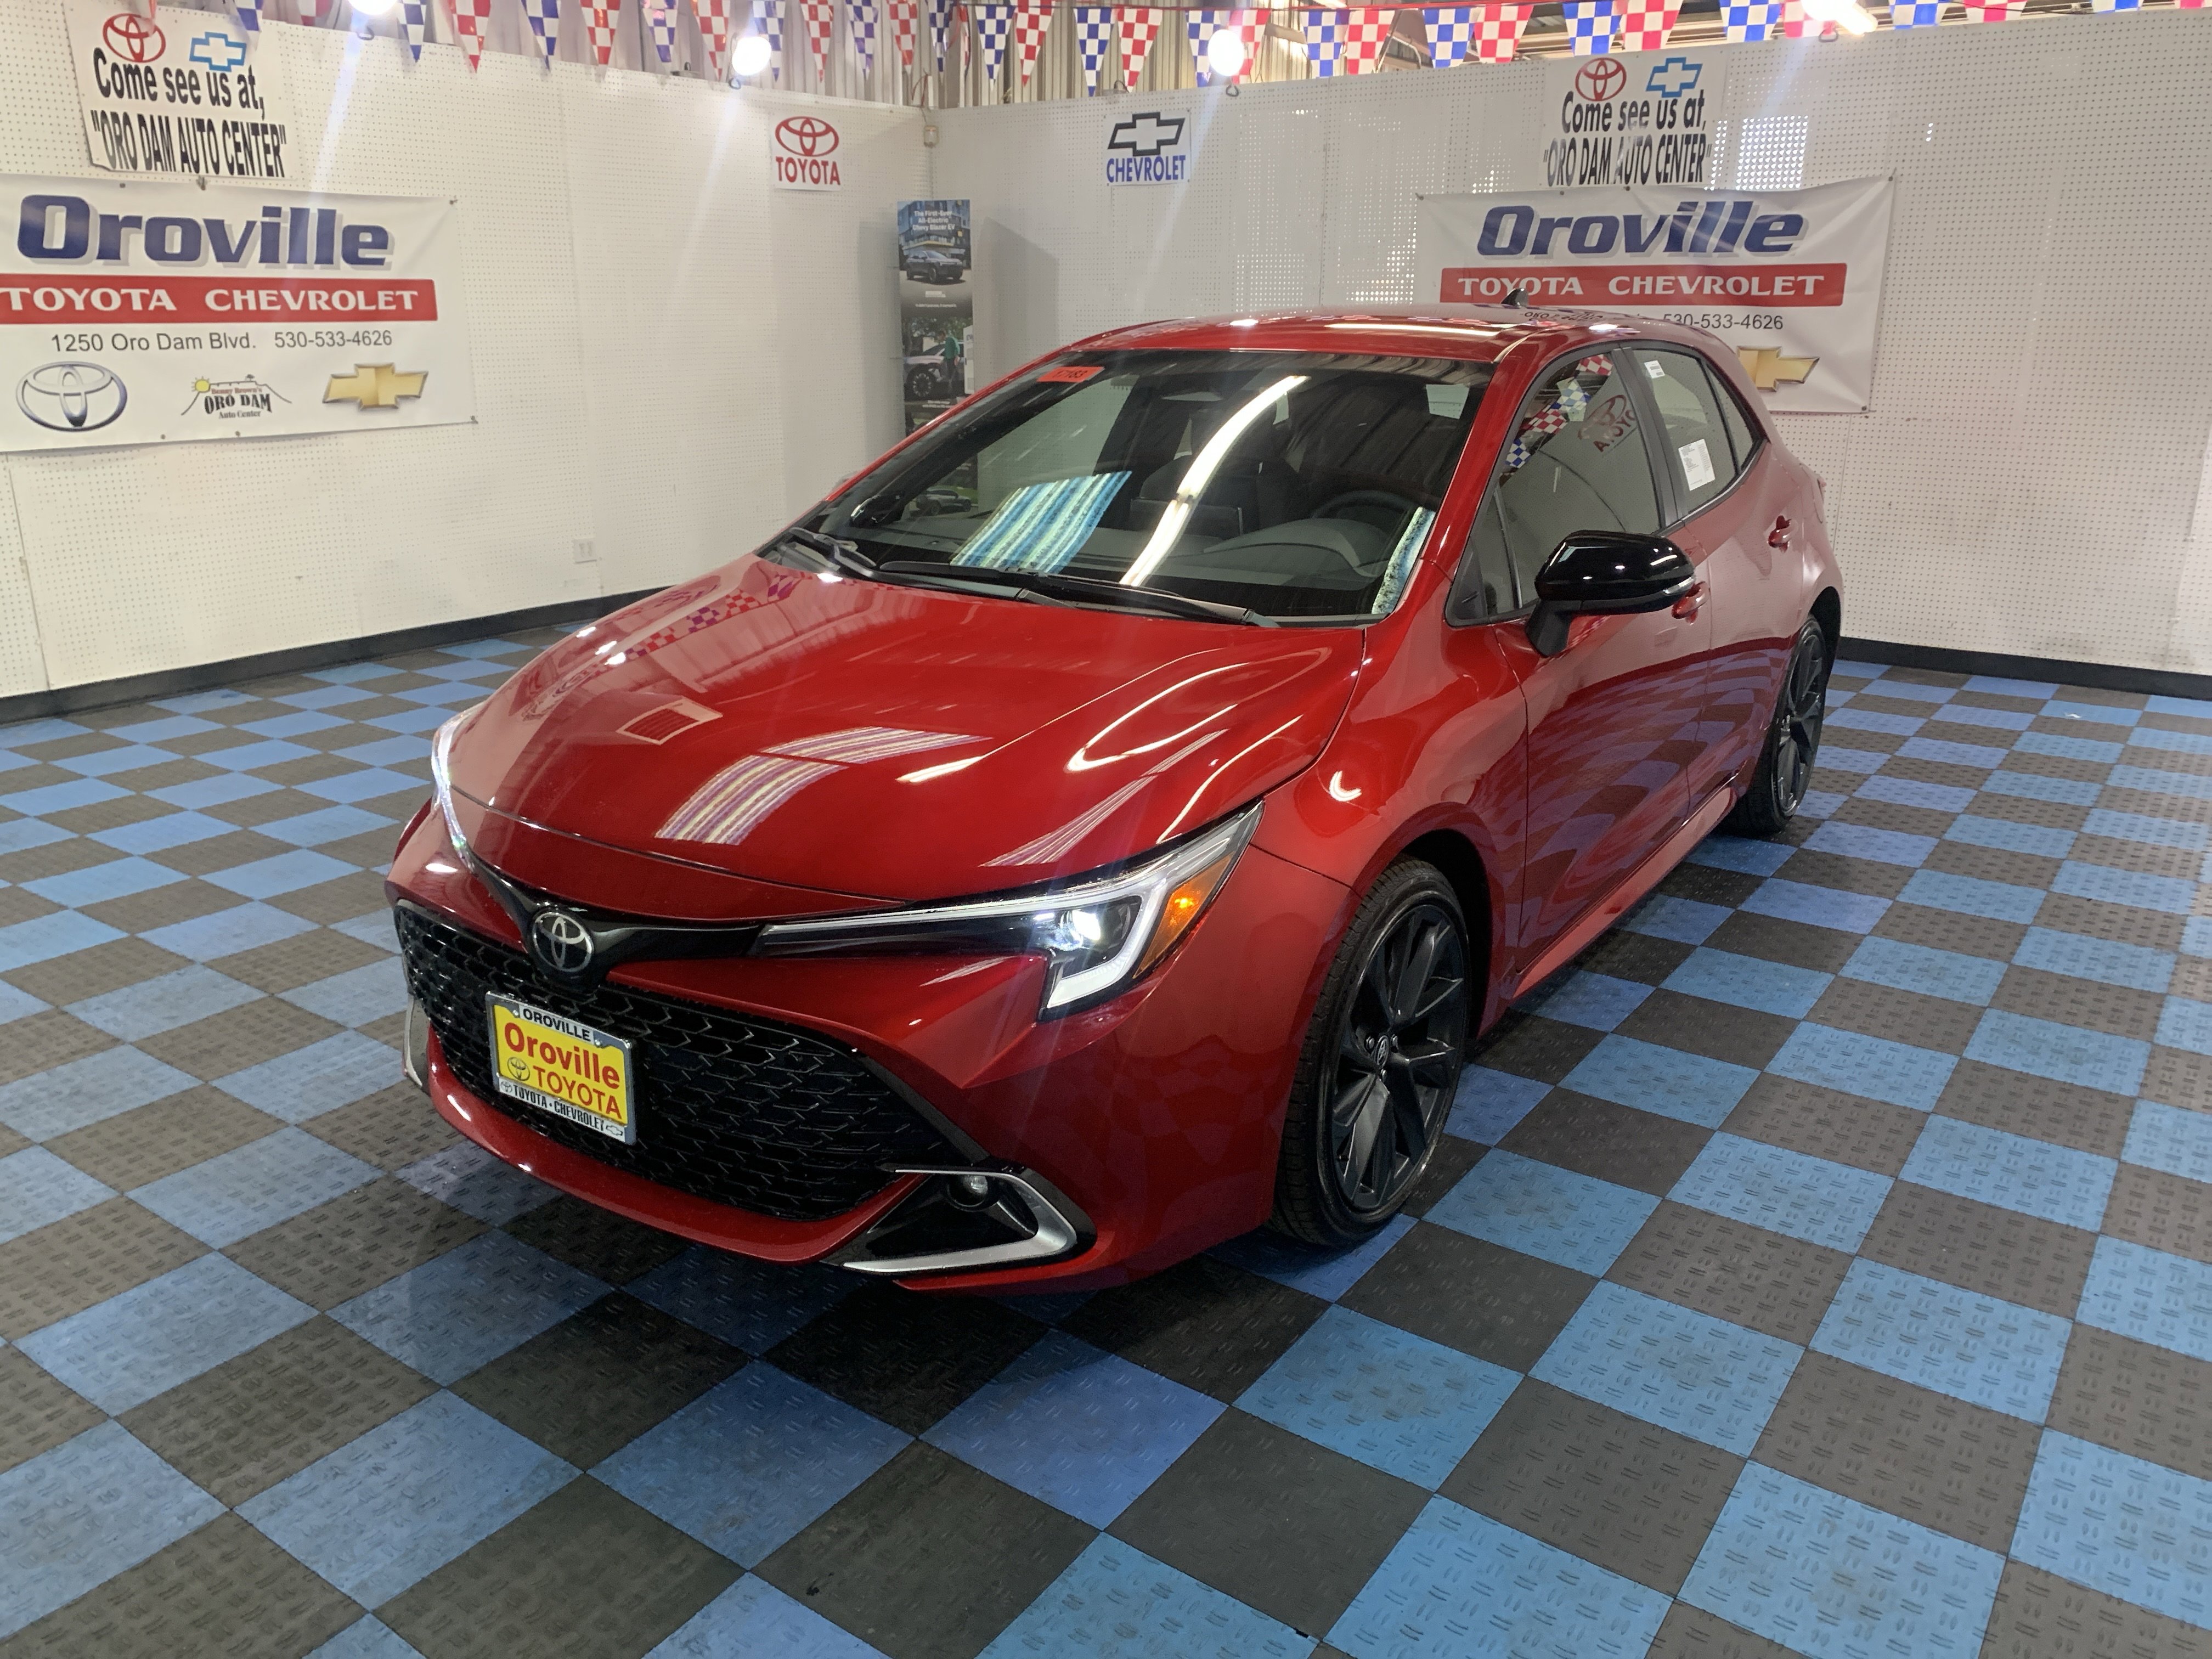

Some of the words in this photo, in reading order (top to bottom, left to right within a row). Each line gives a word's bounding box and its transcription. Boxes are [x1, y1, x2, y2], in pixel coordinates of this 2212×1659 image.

[93, 47, 158, 101] Come
[163, 67, 201, 105] see
[206, 71, 232, 108] us
[237, 65, 265, 120] at,
[1561, 91, 1613, 134] Come
[1618, 99, 1650, 132] see
[1656, 98, 1678, 130] us
[1684, 89, 1707, 131] at,
[91, 110, 138, 171] "ORO
[137, 113, 176, 172] DAM
[177, 116, 220, 174] AUTO
[222, 120, 286, 178] CENTER"
[1543, 137, 1577, 187] "ORO
[1579, 137, 1612, 185] DAM
[1614, 134, 1652, 185] AUTO
[1655, 133, 1712, 184] CENTER"
[775, 156, 841, 186] TOYOTA
[1106, 155, 1186, 184] CHEVROLET
[17, 194, 389, 267] Oroville
[1477, 201, 1804, 256] Oroville
[0, 287, 177, 311] TOYOTA
[205, 289, 419, 312] CHEVROLET
[1458, 276, 1584, 296] TOYOTA
[1609, 275, 1825, 297] CHEVROLET
[52, 334, 104, 352] 1250
[111, 333, 150, 351] Oro
[156, 332, 203, 350] Dam
[209, 332, 256, 349] Blvd.
[275, 330, 393, 348] 530-533-4626
[205, 394, 235, 414] ORO
[240, 393, 272, 413] DAM
[237, 410, 262, 419] Center
[523, 1008, 591, 1042] OROVILLE
[505, 1022, 620, 1090] Oroville
[513, 1084, 548, 1108] TOYOTA
[554, 1101, 605, 1131] CHEVROLET
[533, 1065, 622, 1120] TOYOTA
